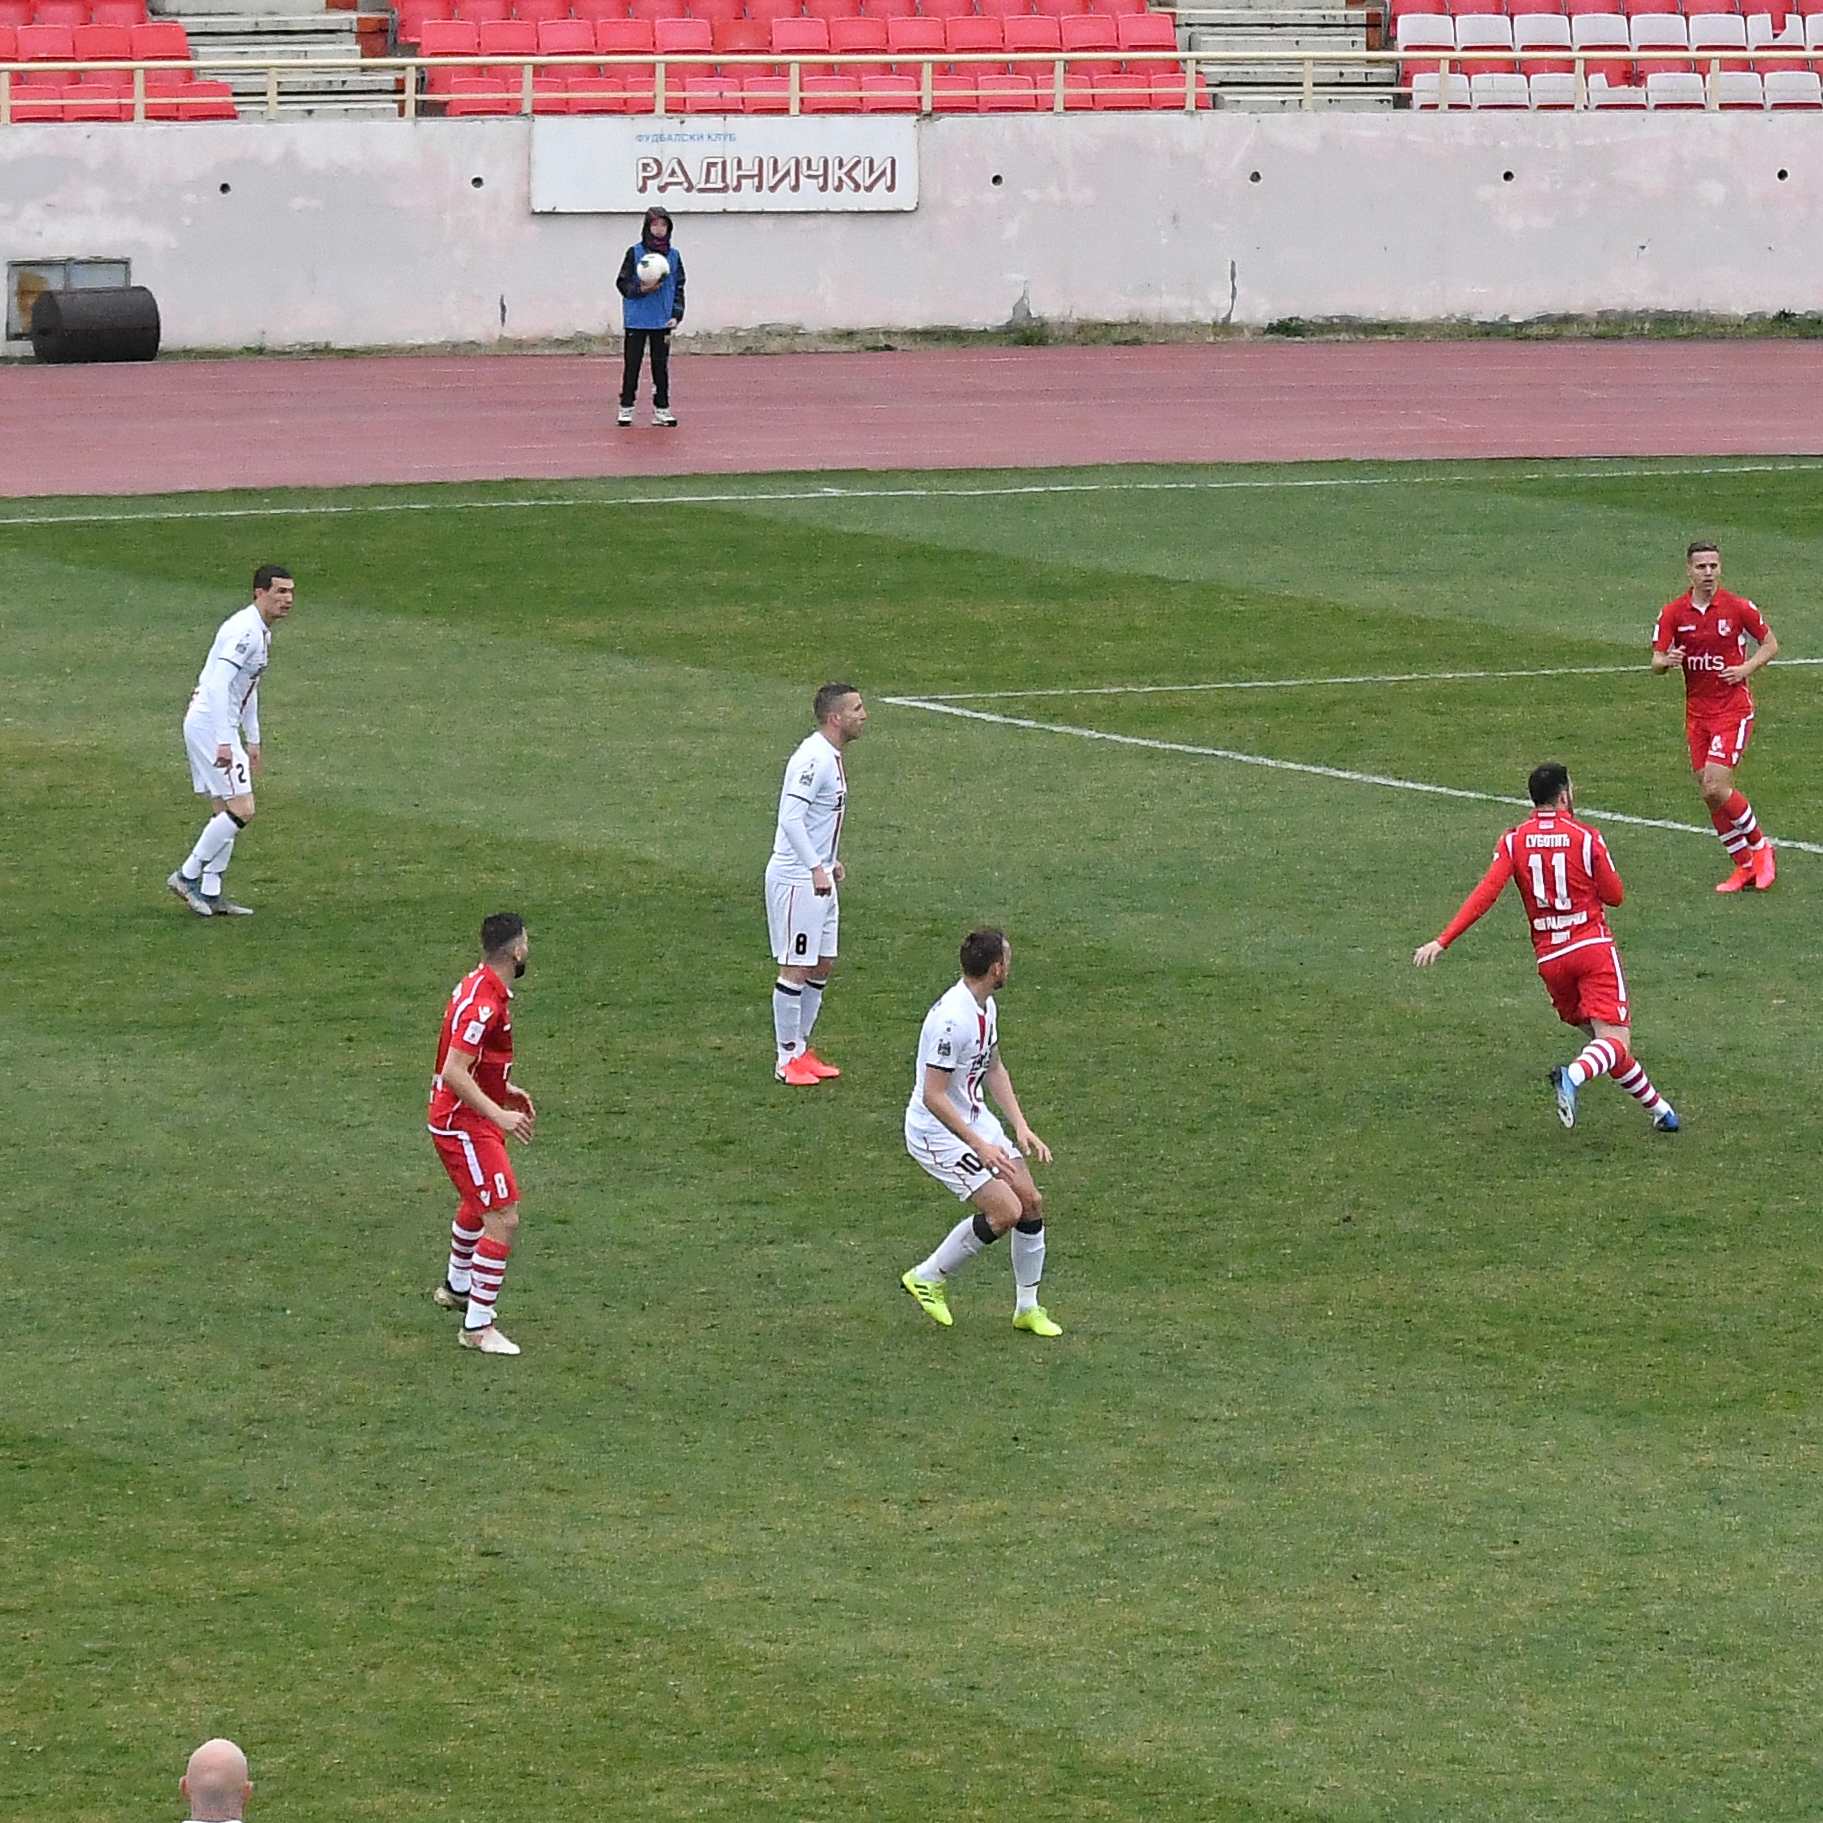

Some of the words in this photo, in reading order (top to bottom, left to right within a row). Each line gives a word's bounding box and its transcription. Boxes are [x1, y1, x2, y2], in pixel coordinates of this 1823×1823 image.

[635, 155, 898, 194] РАДНИЧКИ
[1687, 652, 1725, 671] mts
[236, 762, 247, 784] 2
[1527, 852, 1572, 911] 11
[795, 932, 808, 956] 8
[955, 1152, 985, 1176] 10
[493, 1172, 509, 1200] 8
